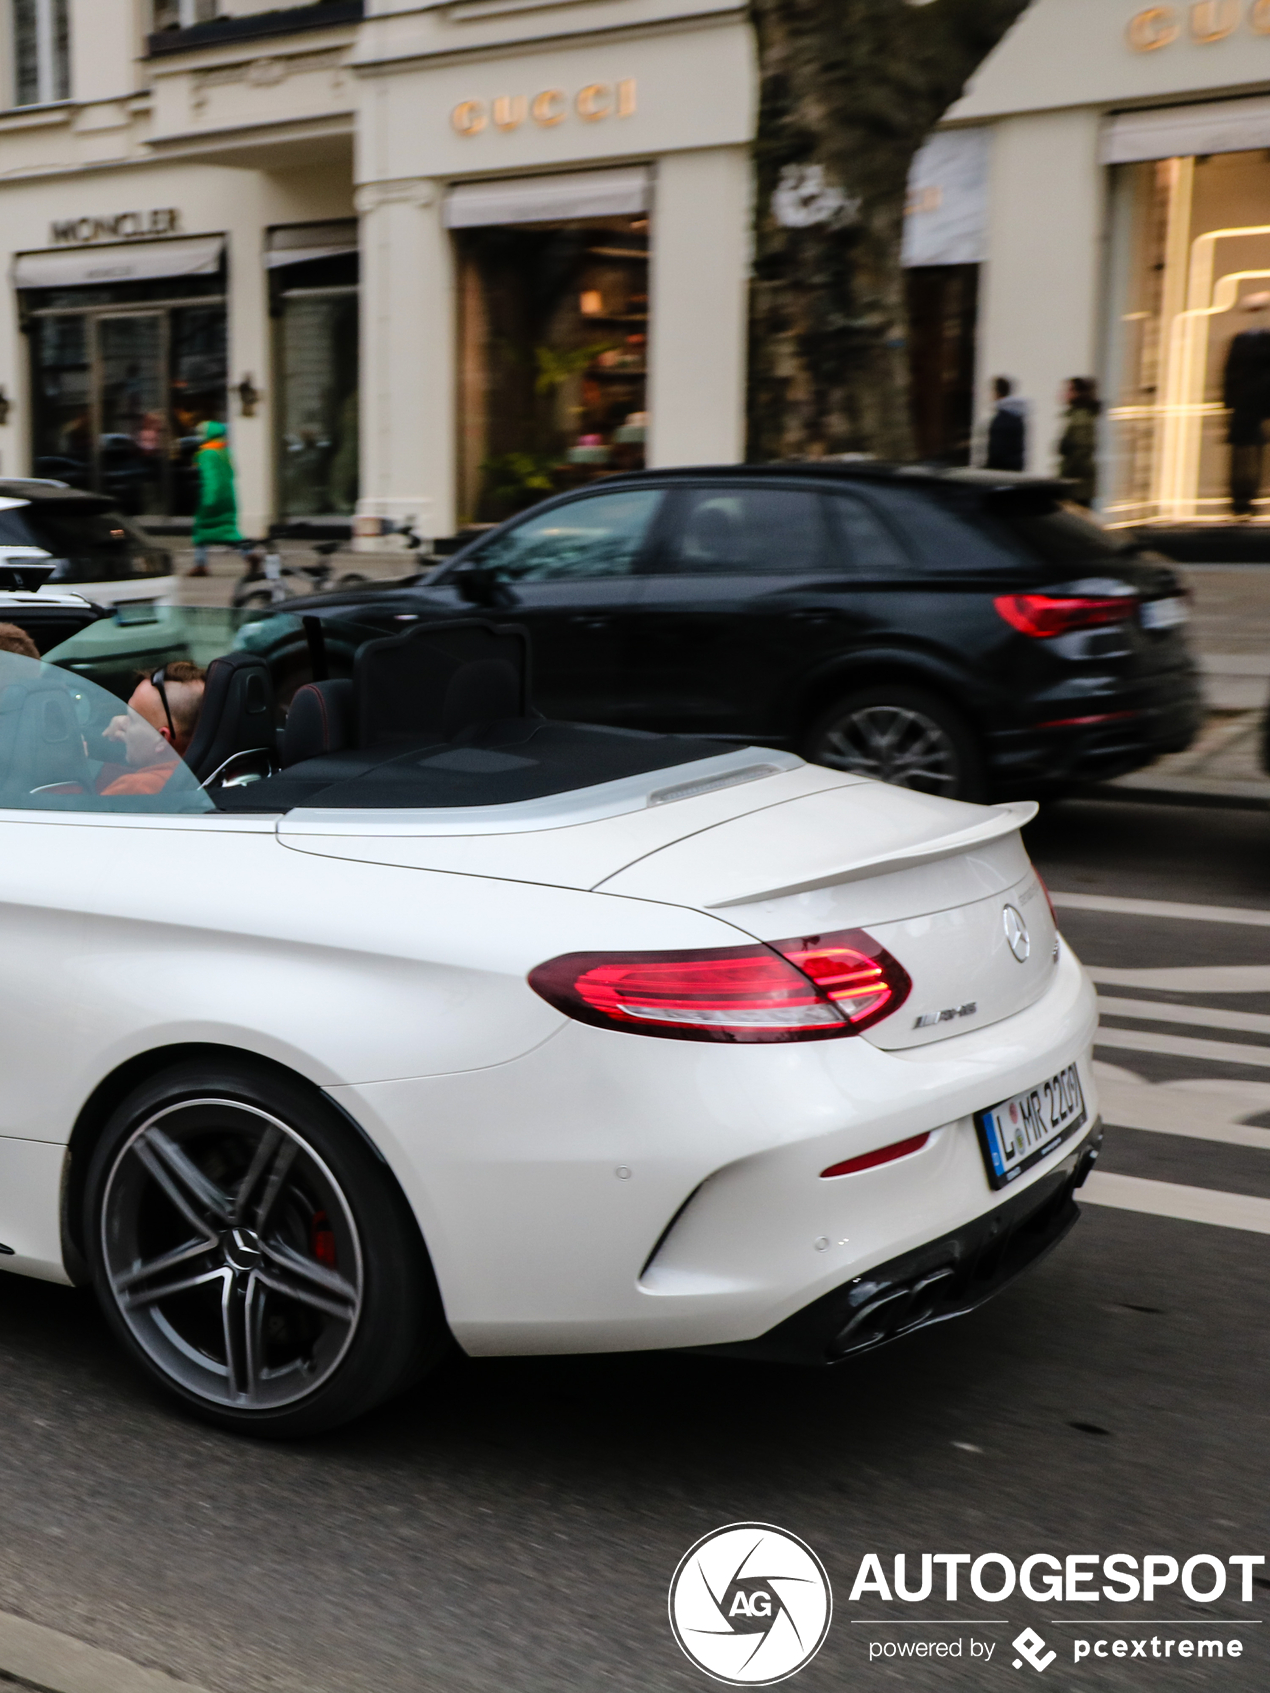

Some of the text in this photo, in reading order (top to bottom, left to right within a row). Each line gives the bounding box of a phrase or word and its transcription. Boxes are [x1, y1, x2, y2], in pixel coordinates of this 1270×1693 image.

[450, 78, 636, 137] GUCCI
[51, 207, 180, 242] MONCLER
[996, 1115, 1016, 1162] L
[1019, 1090, 1048, 1146] MR
